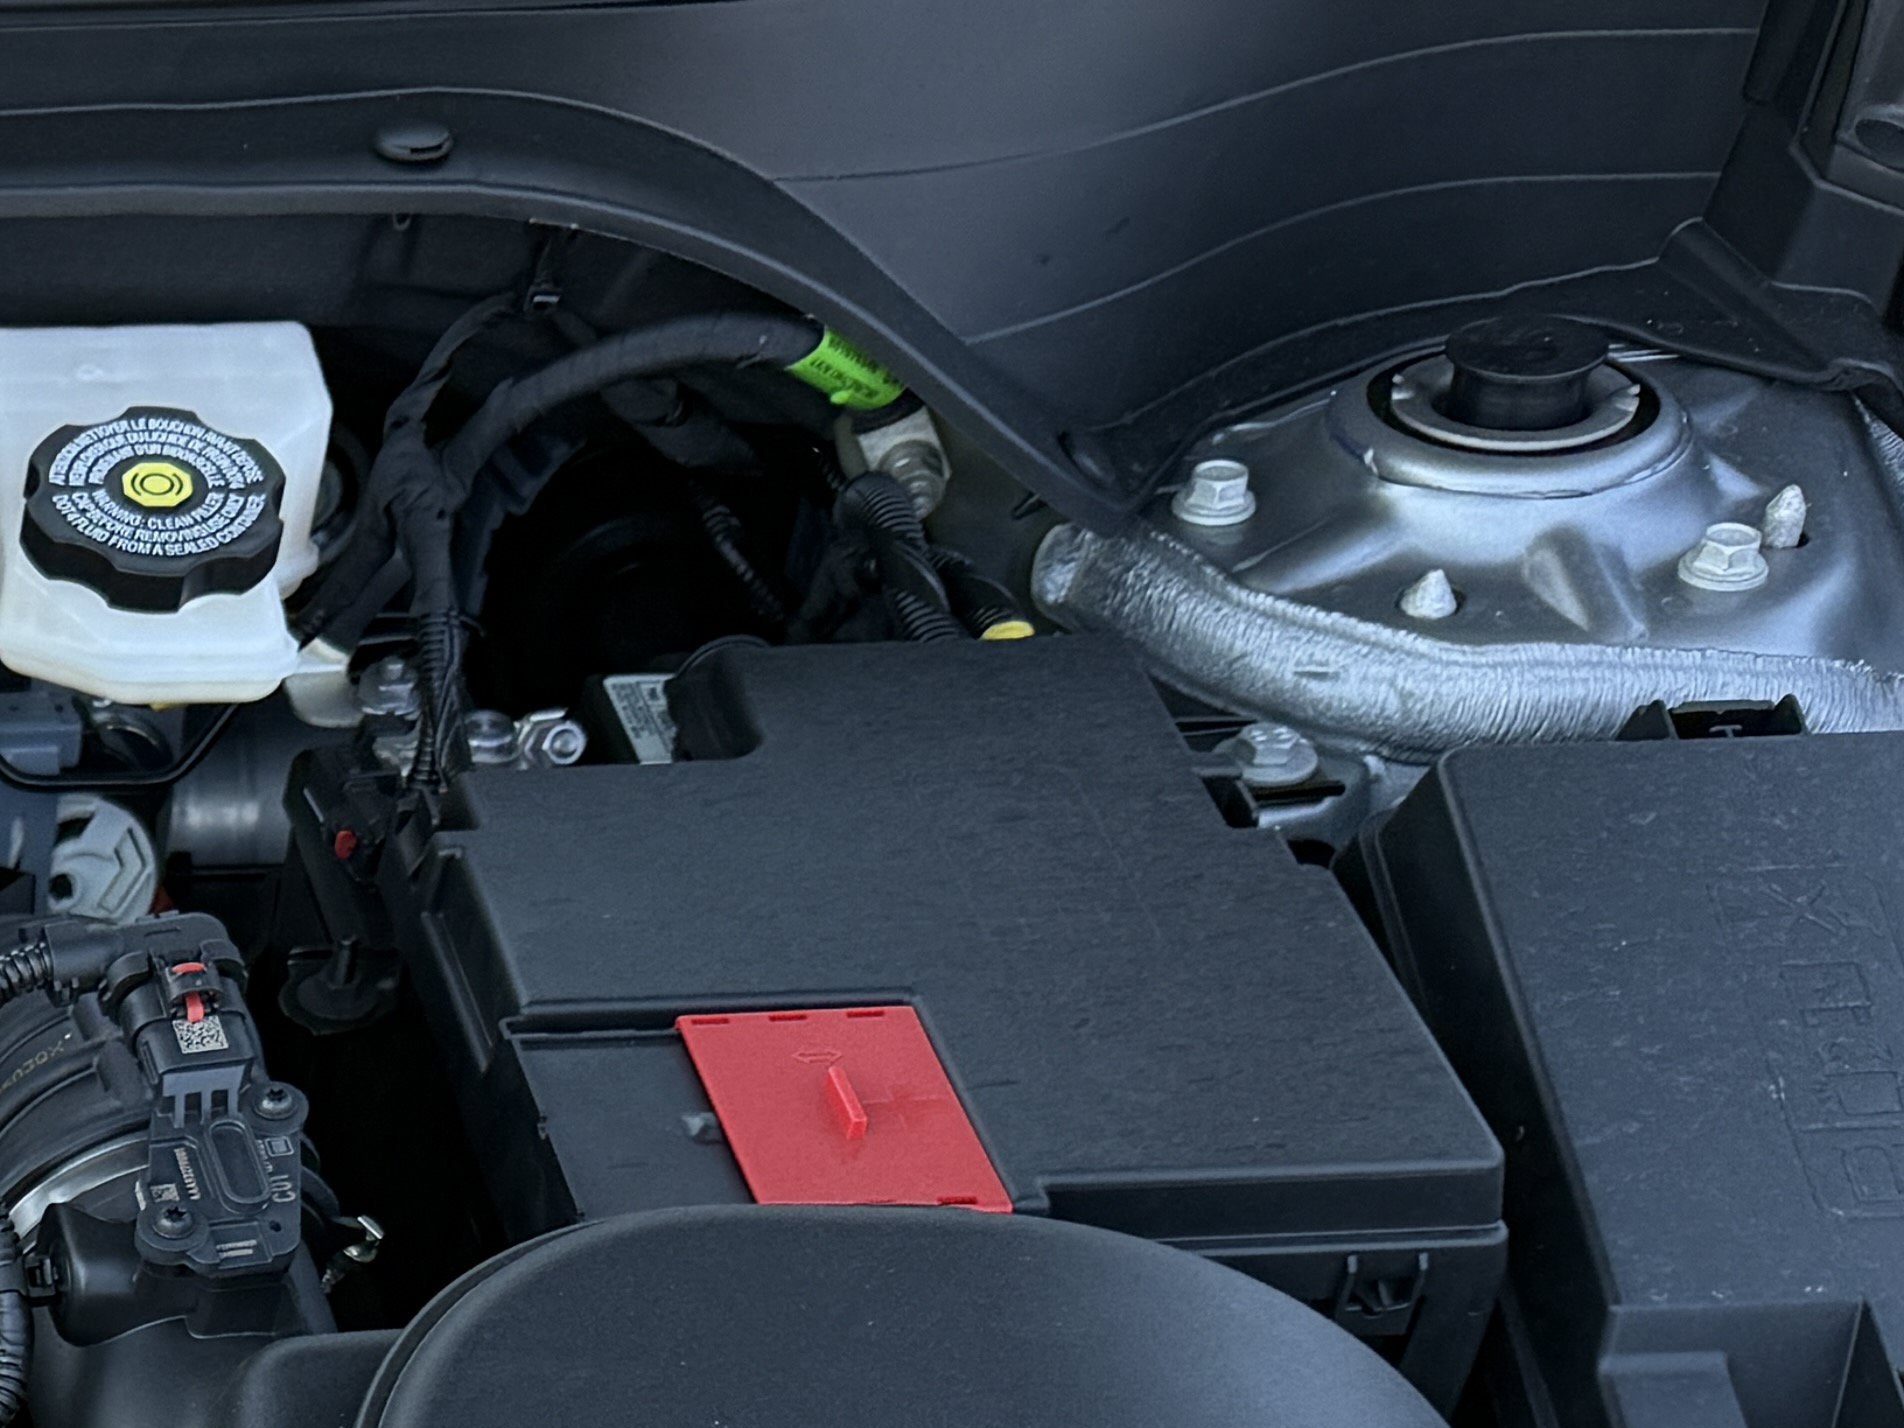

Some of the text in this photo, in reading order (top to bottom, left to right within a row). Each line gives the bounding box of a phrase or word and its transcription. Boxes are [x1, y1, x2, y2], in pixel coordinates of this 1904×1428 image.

[145, 512, 196, 530] CLEAN
[104, 534, 152, 554] FROM
[164, 534, 220, 557] SEALED
